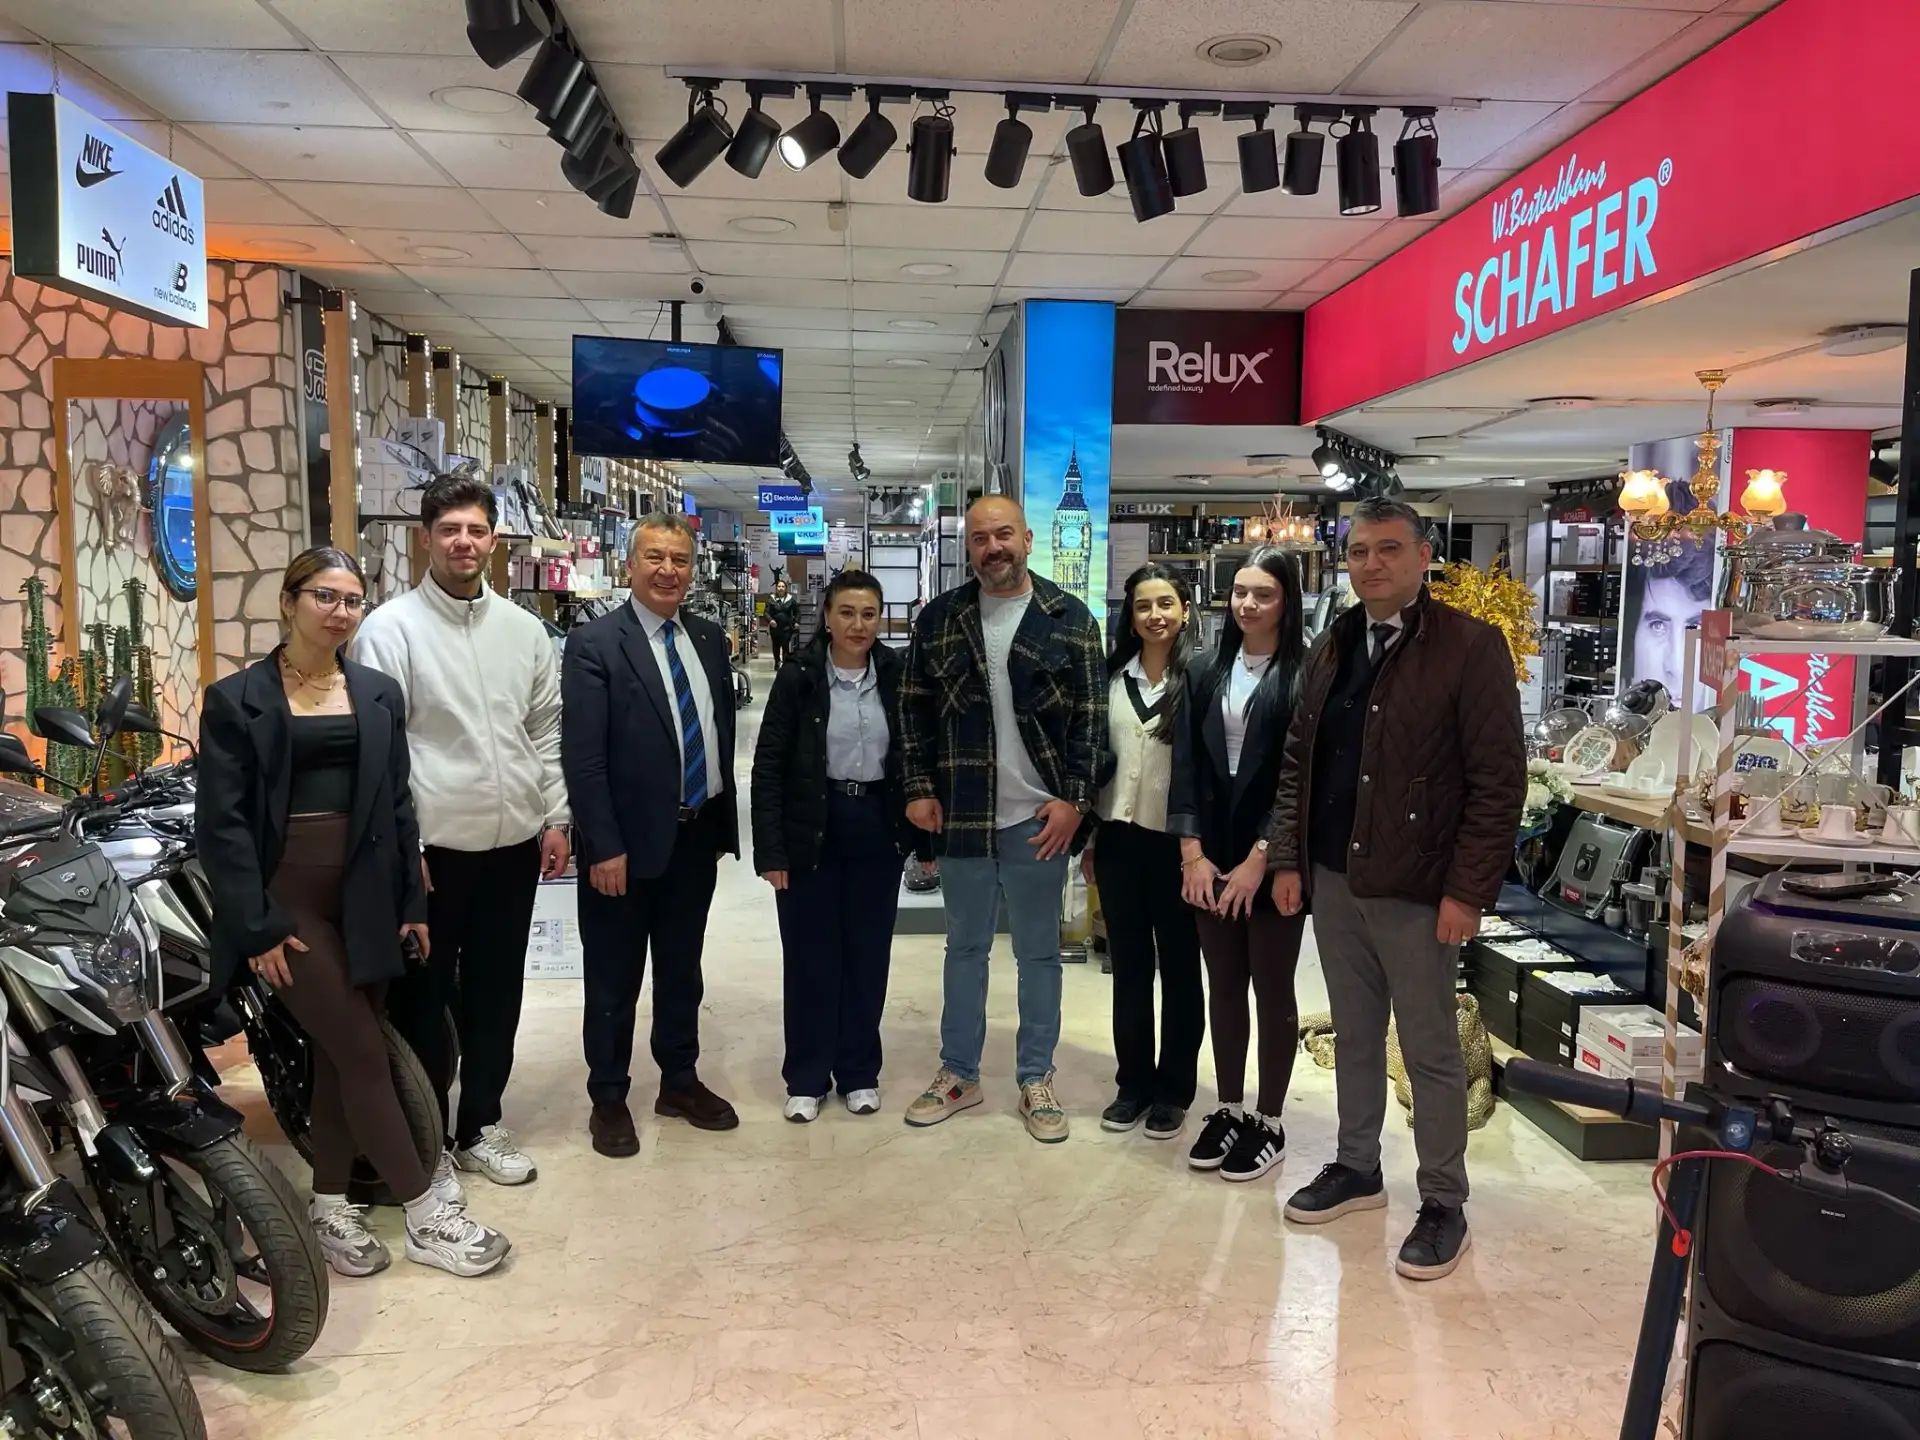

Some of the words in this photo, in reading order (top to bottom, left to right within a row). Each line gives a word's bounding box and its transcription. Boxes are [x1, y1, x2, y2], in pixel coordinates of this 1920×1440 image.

[82, 133, 114, 172] NIKE
[152, 209, 195, 246] adidas
[76, 242, 117, 283] PUMA
[153, 286, 168, 303] new
[169, 291, 197, 312] balance
[1148, 340, 1271, 394] Relux
[1148, 384, 1180, 392] redefined
[1182, 384, 1204, 394] luxury
[773, 494, 805, 503] Electrolux
